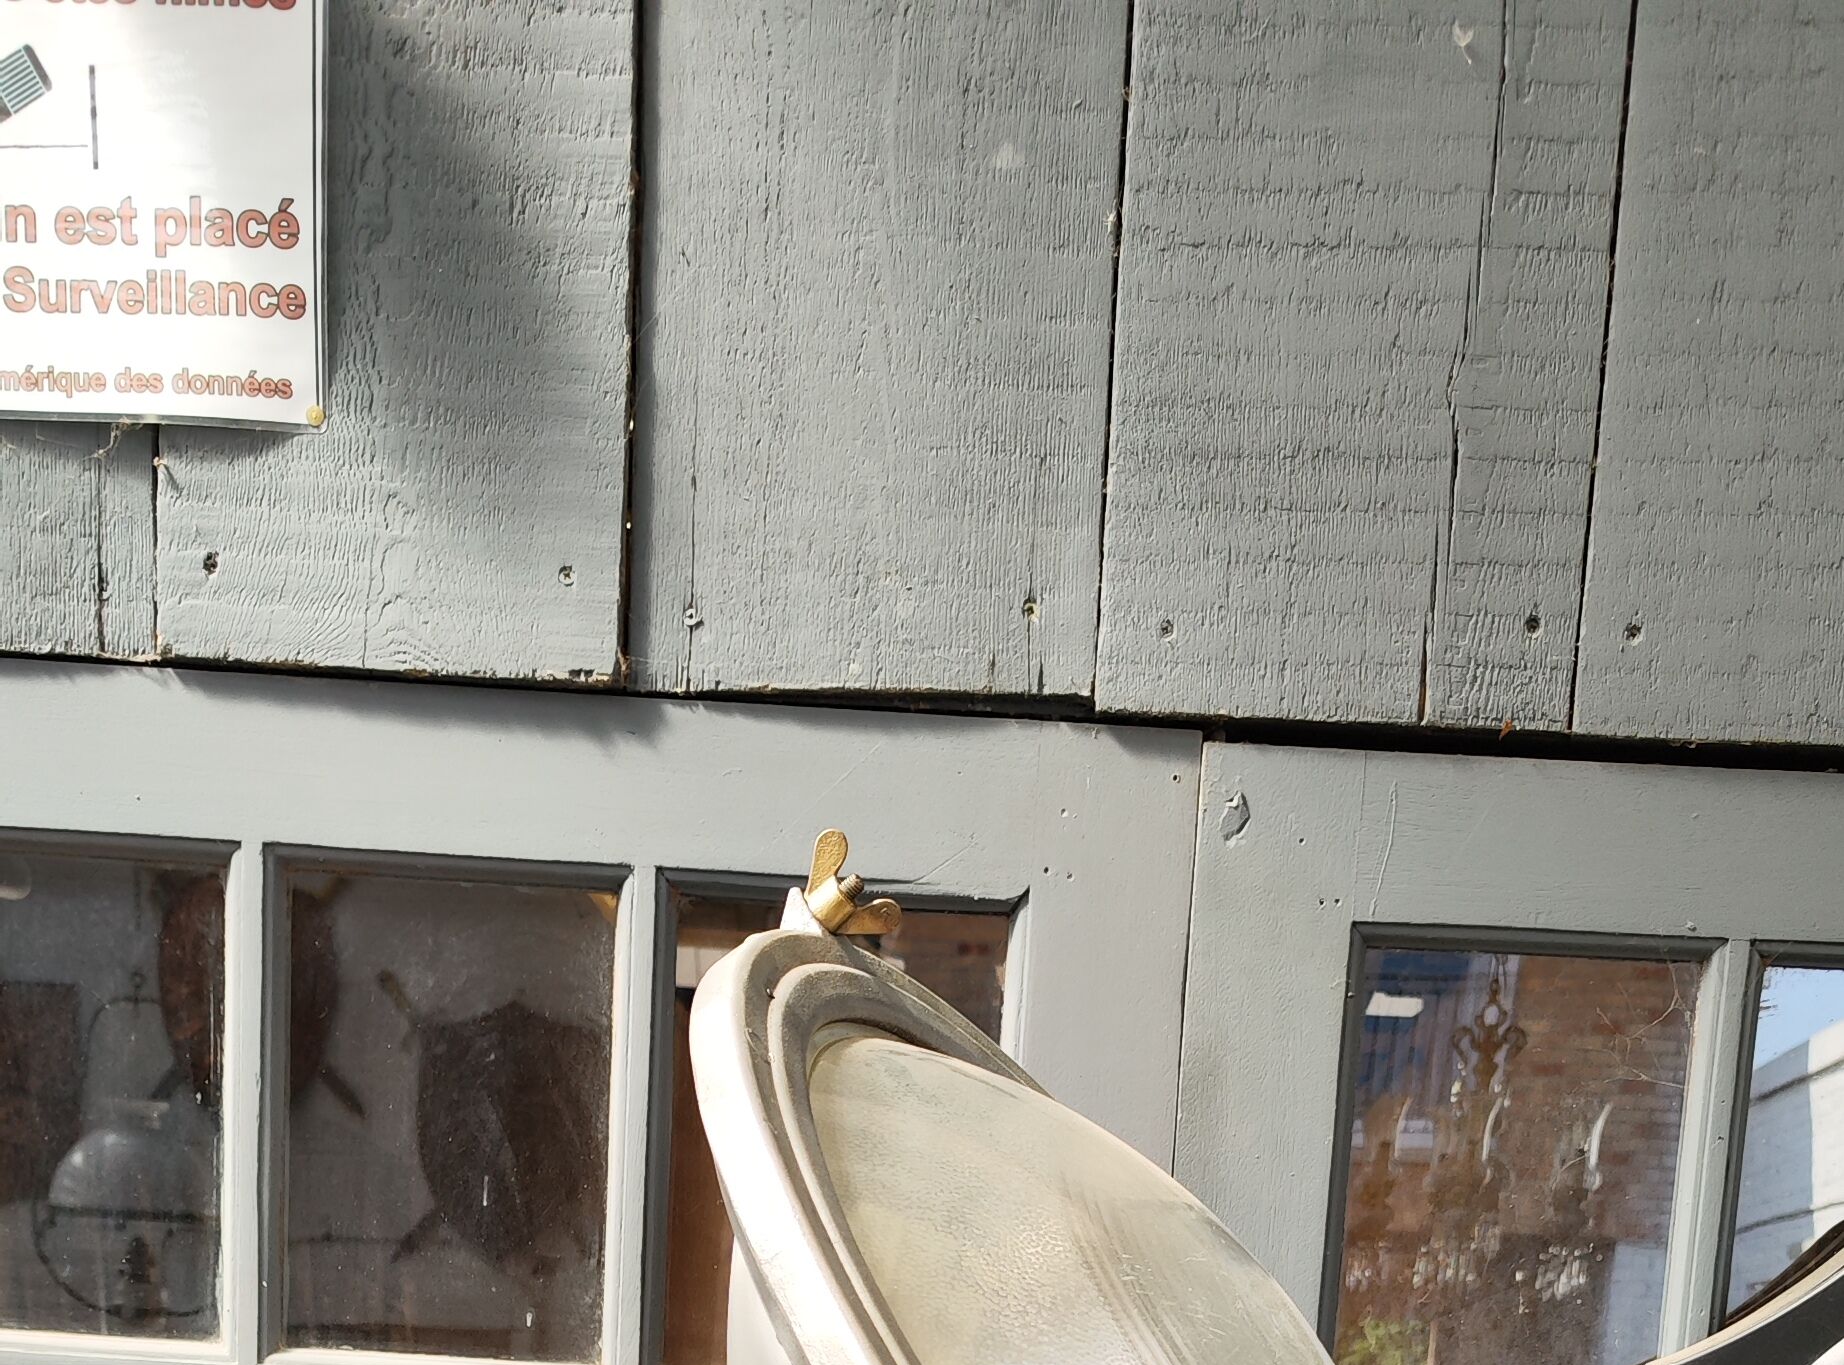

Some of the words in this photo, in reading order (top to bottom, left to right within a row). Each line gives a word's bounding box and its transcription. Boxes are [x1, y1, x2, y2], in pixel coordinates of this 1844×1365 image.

[0, 204, 37, 243] n
[54, 195, 139, 246] est
[154, 195, 300, 258] placé
[3, 265, 307, 320] Surveillance
[0, 364, 106, 399] mérique
[114, 366, 164, 395] des
[171, 368, 293, 400] données
